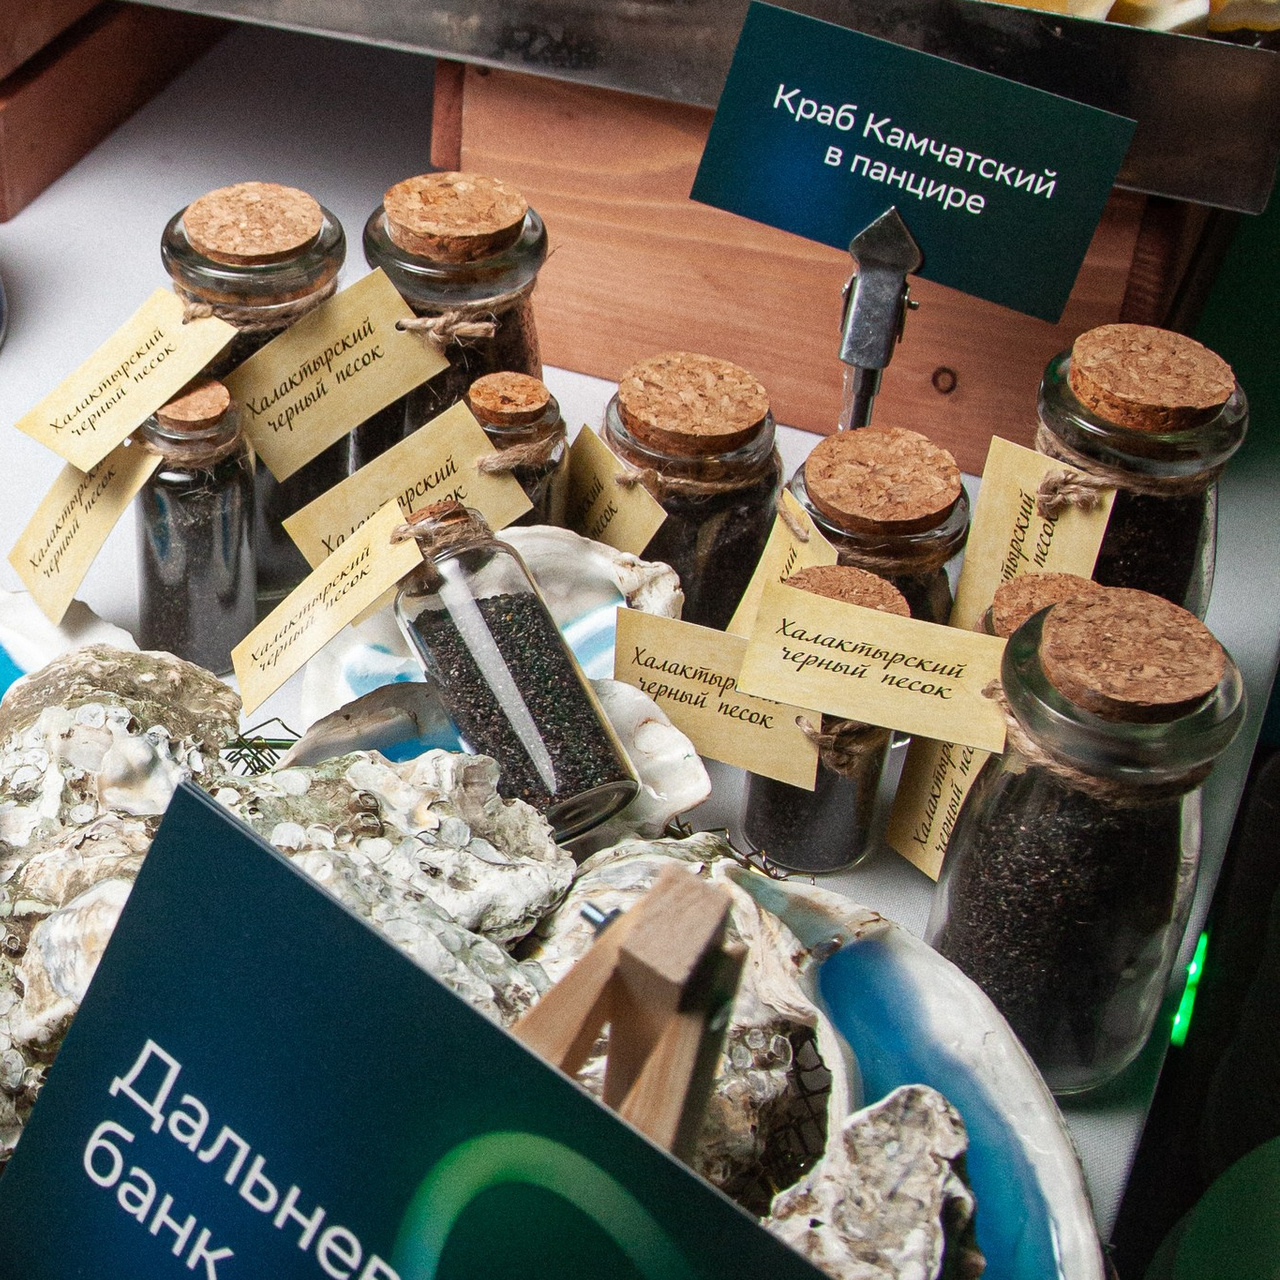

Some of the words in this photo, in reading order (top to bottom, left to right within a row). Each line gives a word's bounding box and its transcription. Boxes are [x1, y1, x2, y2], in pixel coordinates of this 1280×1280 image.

[772, 83, 858, 132] Краб
[862, 113, 1057, 199] Камчатский
[823, 144, 842, 167] в
[850, 153, 986, 215] панцире
[49, 326, 166, 434] Халактырский
[70, 386, 128, 437] черный
[133, 343, 177, 384] песок
[246, 316, 376, 420] Халактырский
[267, 377, 329, 432] черный
[335, 344, 385, 385] песок
[43, 515, 81, 578] черный
[83, 465, 117, 514] песок
[250, 544, 372, 667] Халактырский
[325, 564, 372, 611] песок
[775, 617, 968, 679] Халактырский
[781, 646, 871, 679] черный
[880, 673, 953, 700] песок
[638, 677, 708, 709] черный
[717, 701, 774, 730] песок
